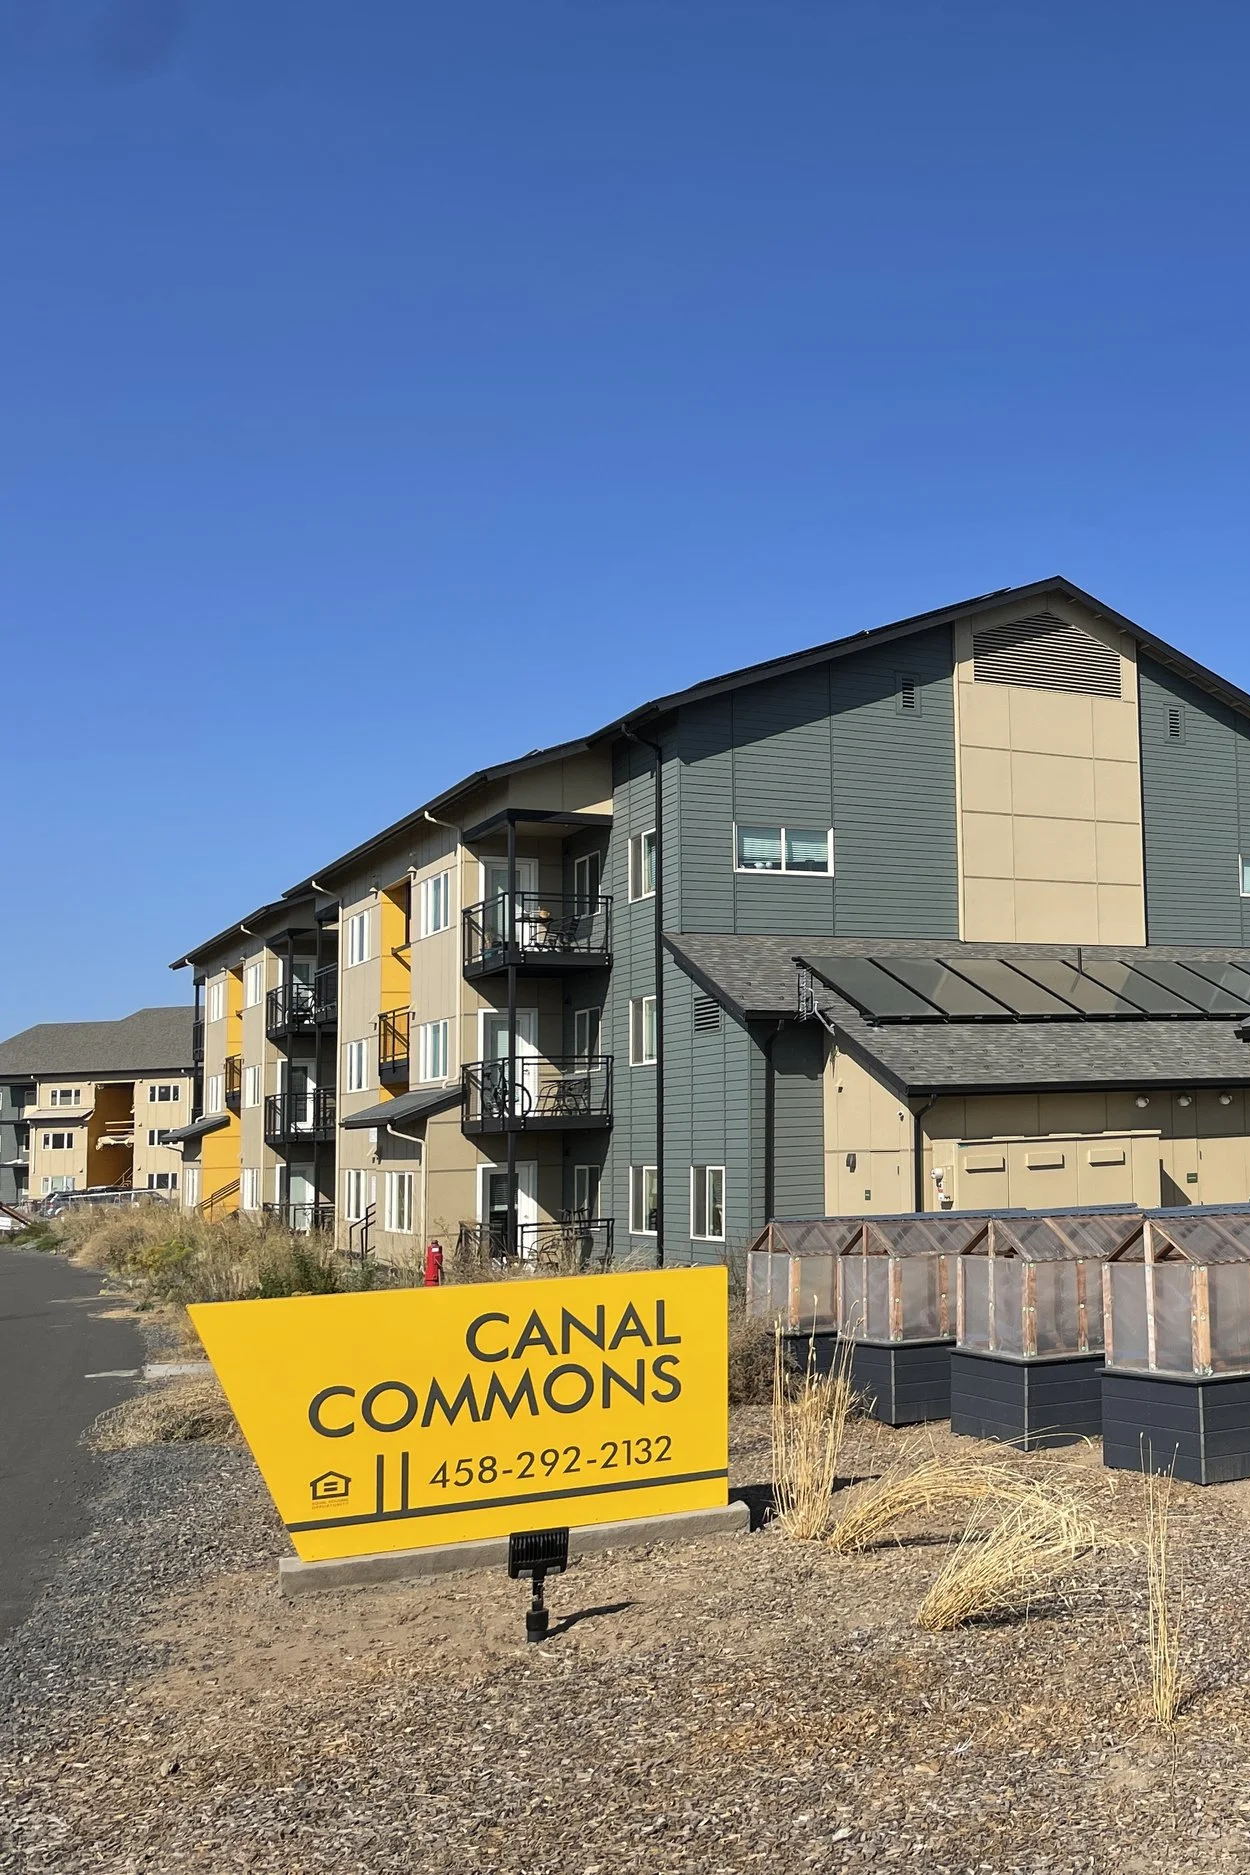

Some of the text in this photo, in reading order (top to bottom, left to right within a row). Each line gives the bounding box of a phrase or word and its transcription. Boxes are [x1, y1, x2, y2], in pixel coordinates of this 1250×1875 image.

[465, 1299, 682, 1363] CANAL
[308, 1354, 682, 1438] COMMONS
[429, 1435, 672, 1488] 458-292-2132
